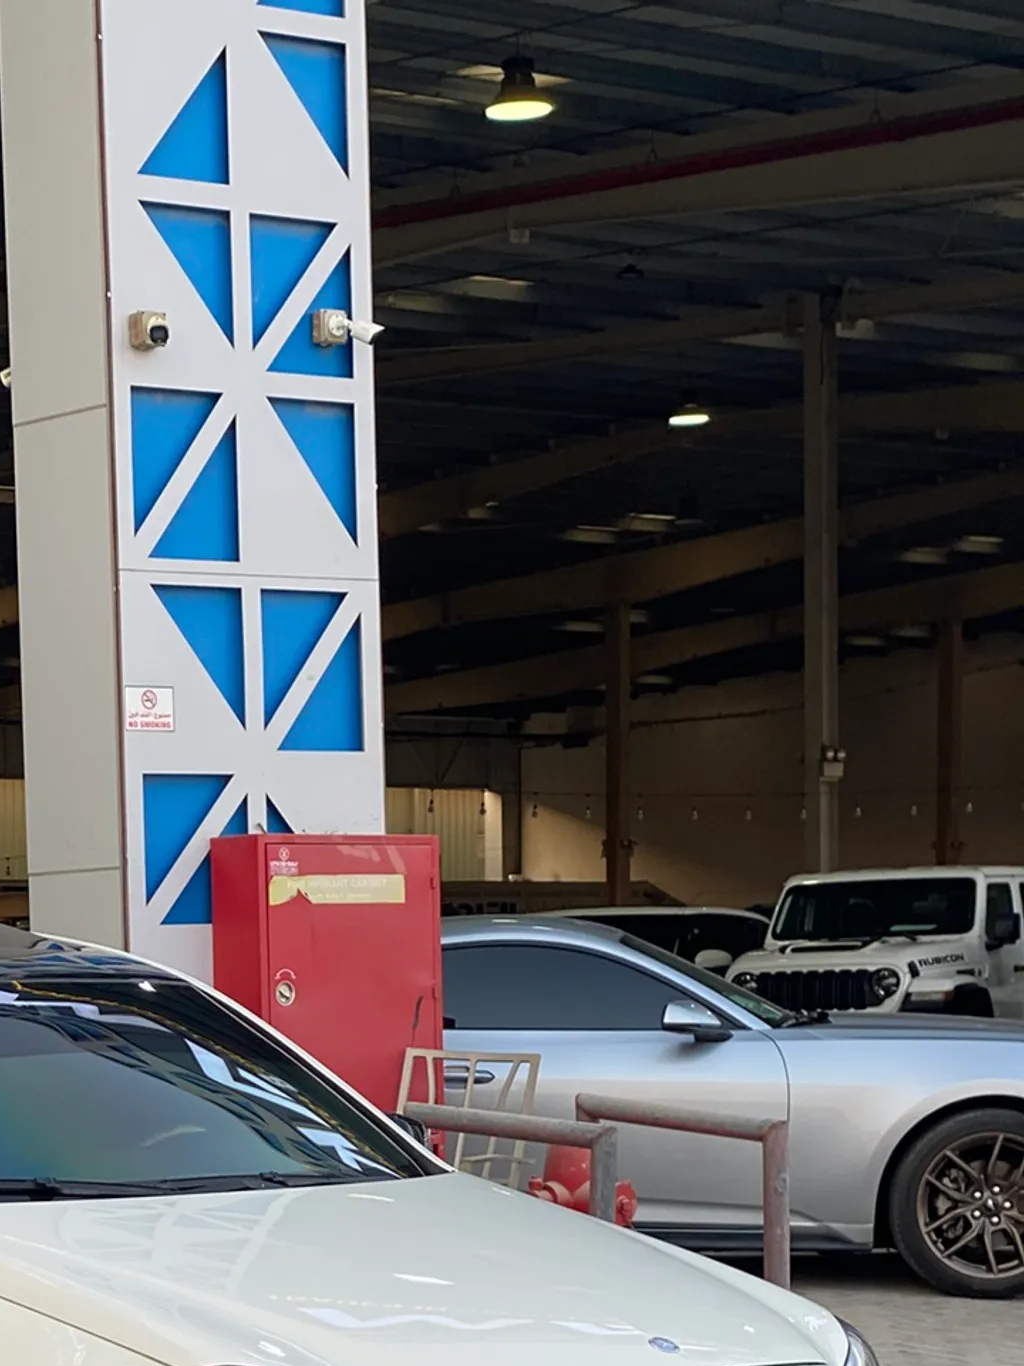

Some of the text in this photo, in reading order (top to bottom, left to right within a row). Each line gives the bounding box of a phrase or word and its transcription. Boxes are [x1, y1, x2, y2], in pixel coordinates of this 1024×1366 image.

[128, 720, 172, 728] NO SMOKING
[918, 953, 965, 967] RUBICON
